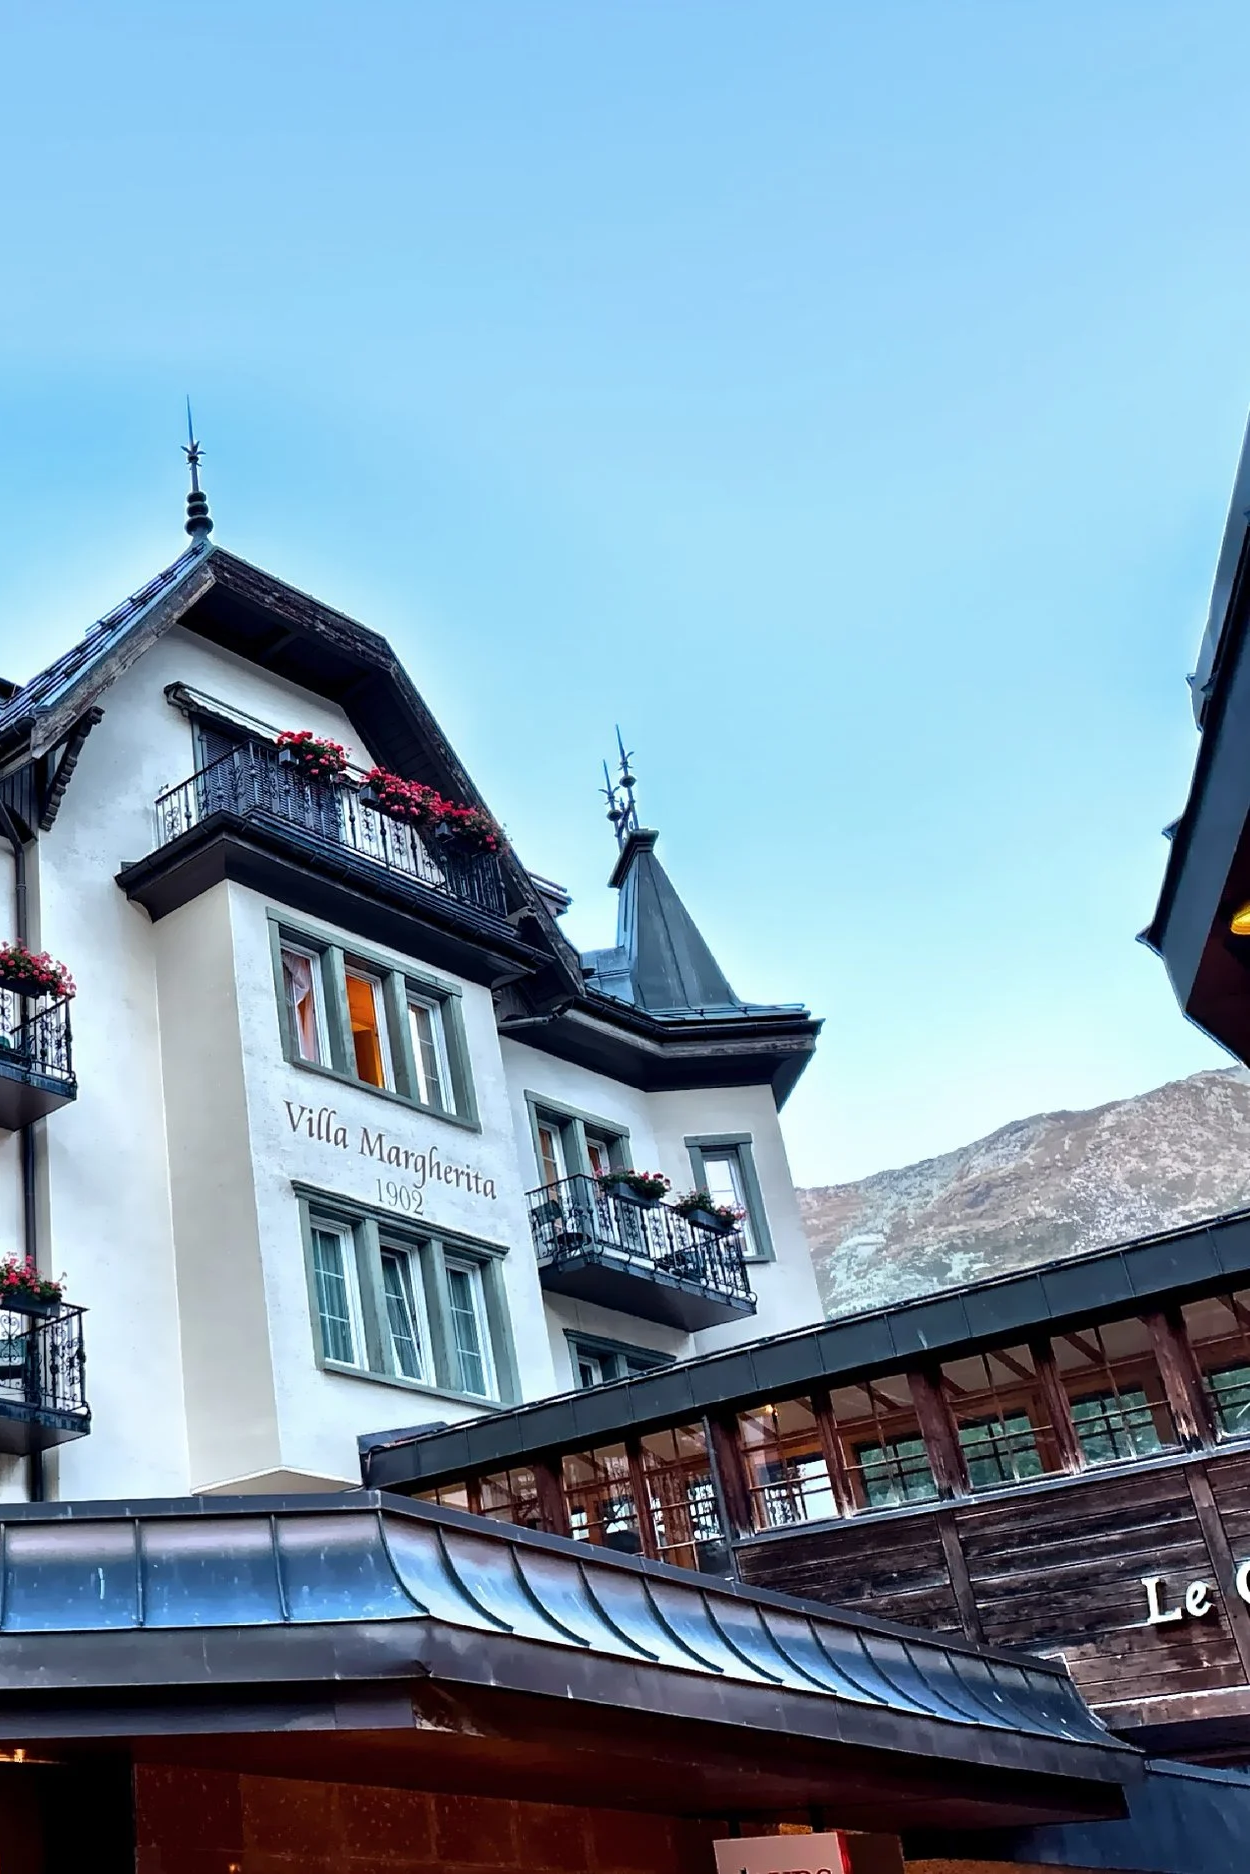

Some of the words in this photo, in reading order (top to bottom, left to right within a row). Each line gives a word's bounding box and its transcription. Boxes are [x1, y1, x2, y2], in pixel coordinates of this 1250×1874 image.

[283, 1100, 349, 1149] Villa
[358, 1126, 497, 1200] Margherita
[375, 1178, 425, 1216] 1902
[1140, 1577, 1212, 1624] Le
